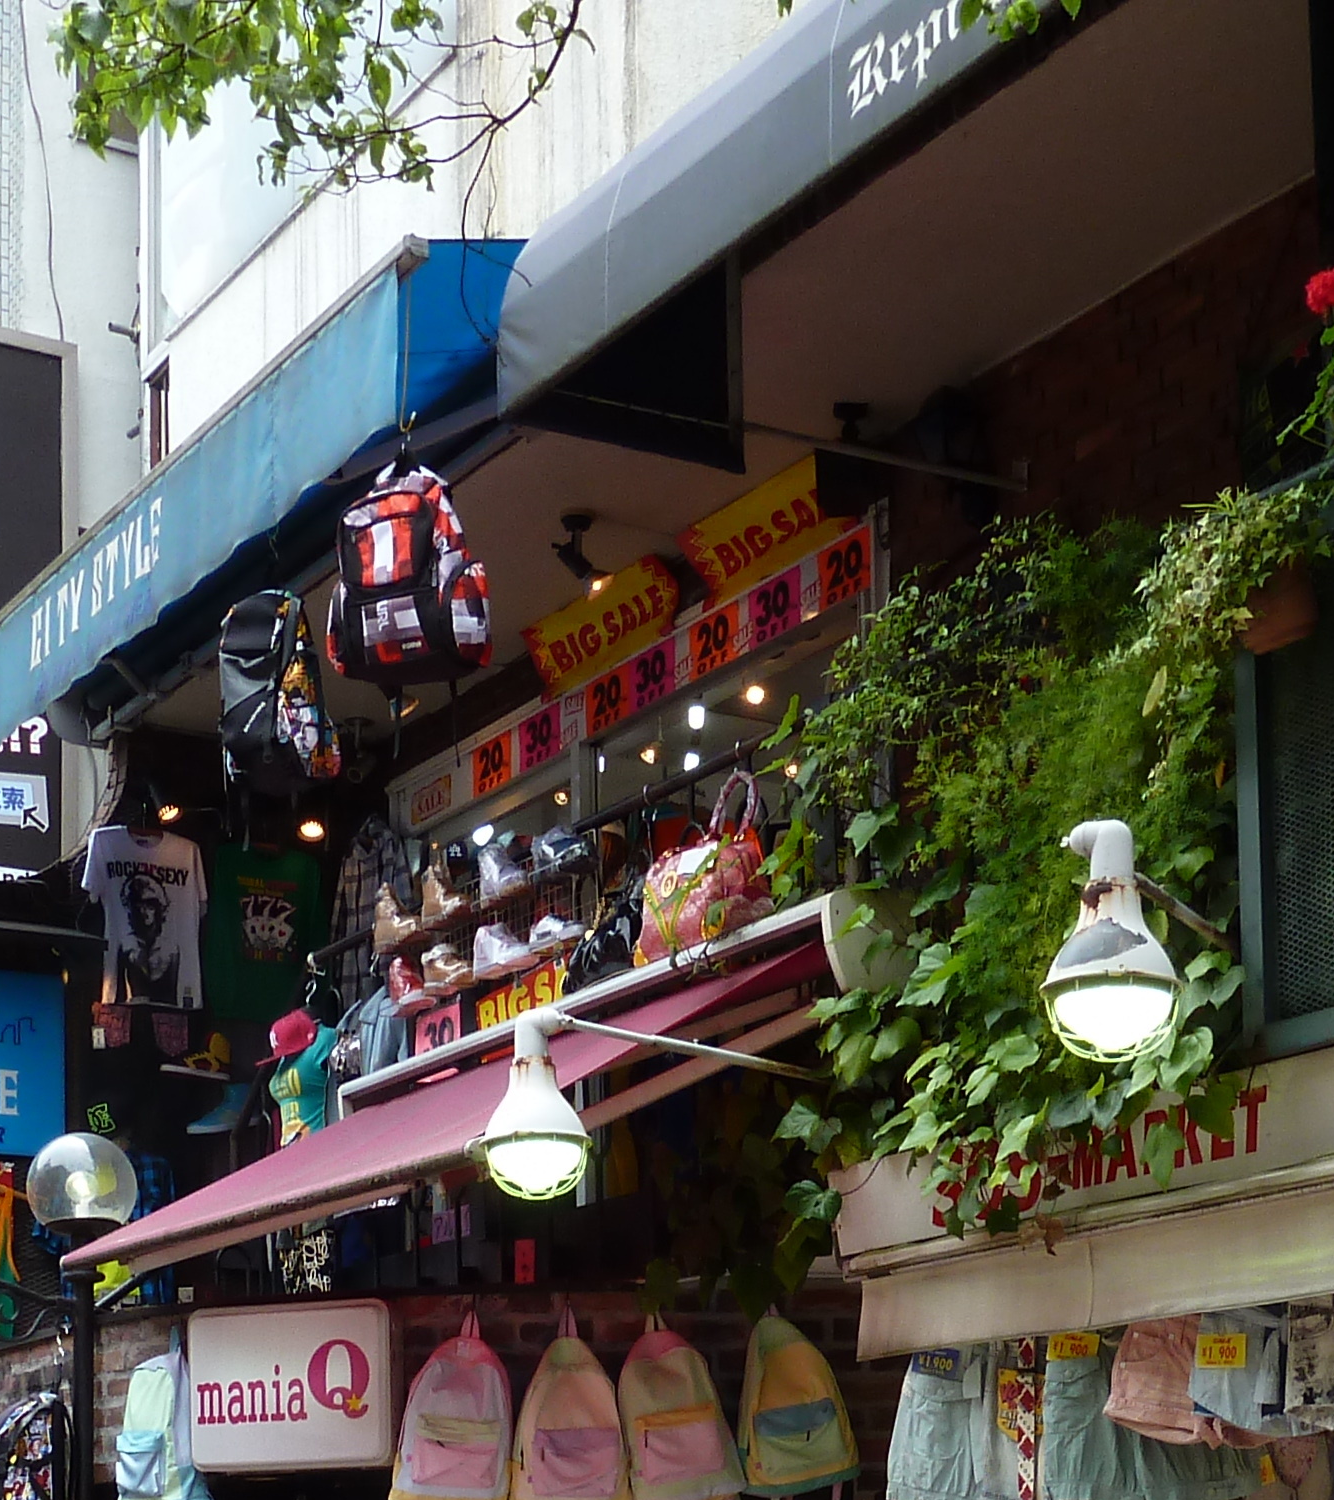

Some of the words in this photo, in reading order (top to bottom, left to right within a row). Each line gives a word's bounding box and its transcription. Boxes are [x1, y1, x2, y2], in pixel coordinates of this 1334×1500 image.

[711, 523, 774, 580] BIG
[826, 538, 863, 581] 20
[29, 568, 86, 672] CITY
[90, 496, 163, 618] STYLE
[755, 592, 791, 628] 30
[548, 626, 603, 675] BIG
[605, 584, 665, 646] SALE
[696, 618, 729, 655] 20
[635, 659, 666, 694] 30
[592, 679, 621, 715] 20
[525, 713, 552, 748] 30
[477, 740, 504, 776] 20
